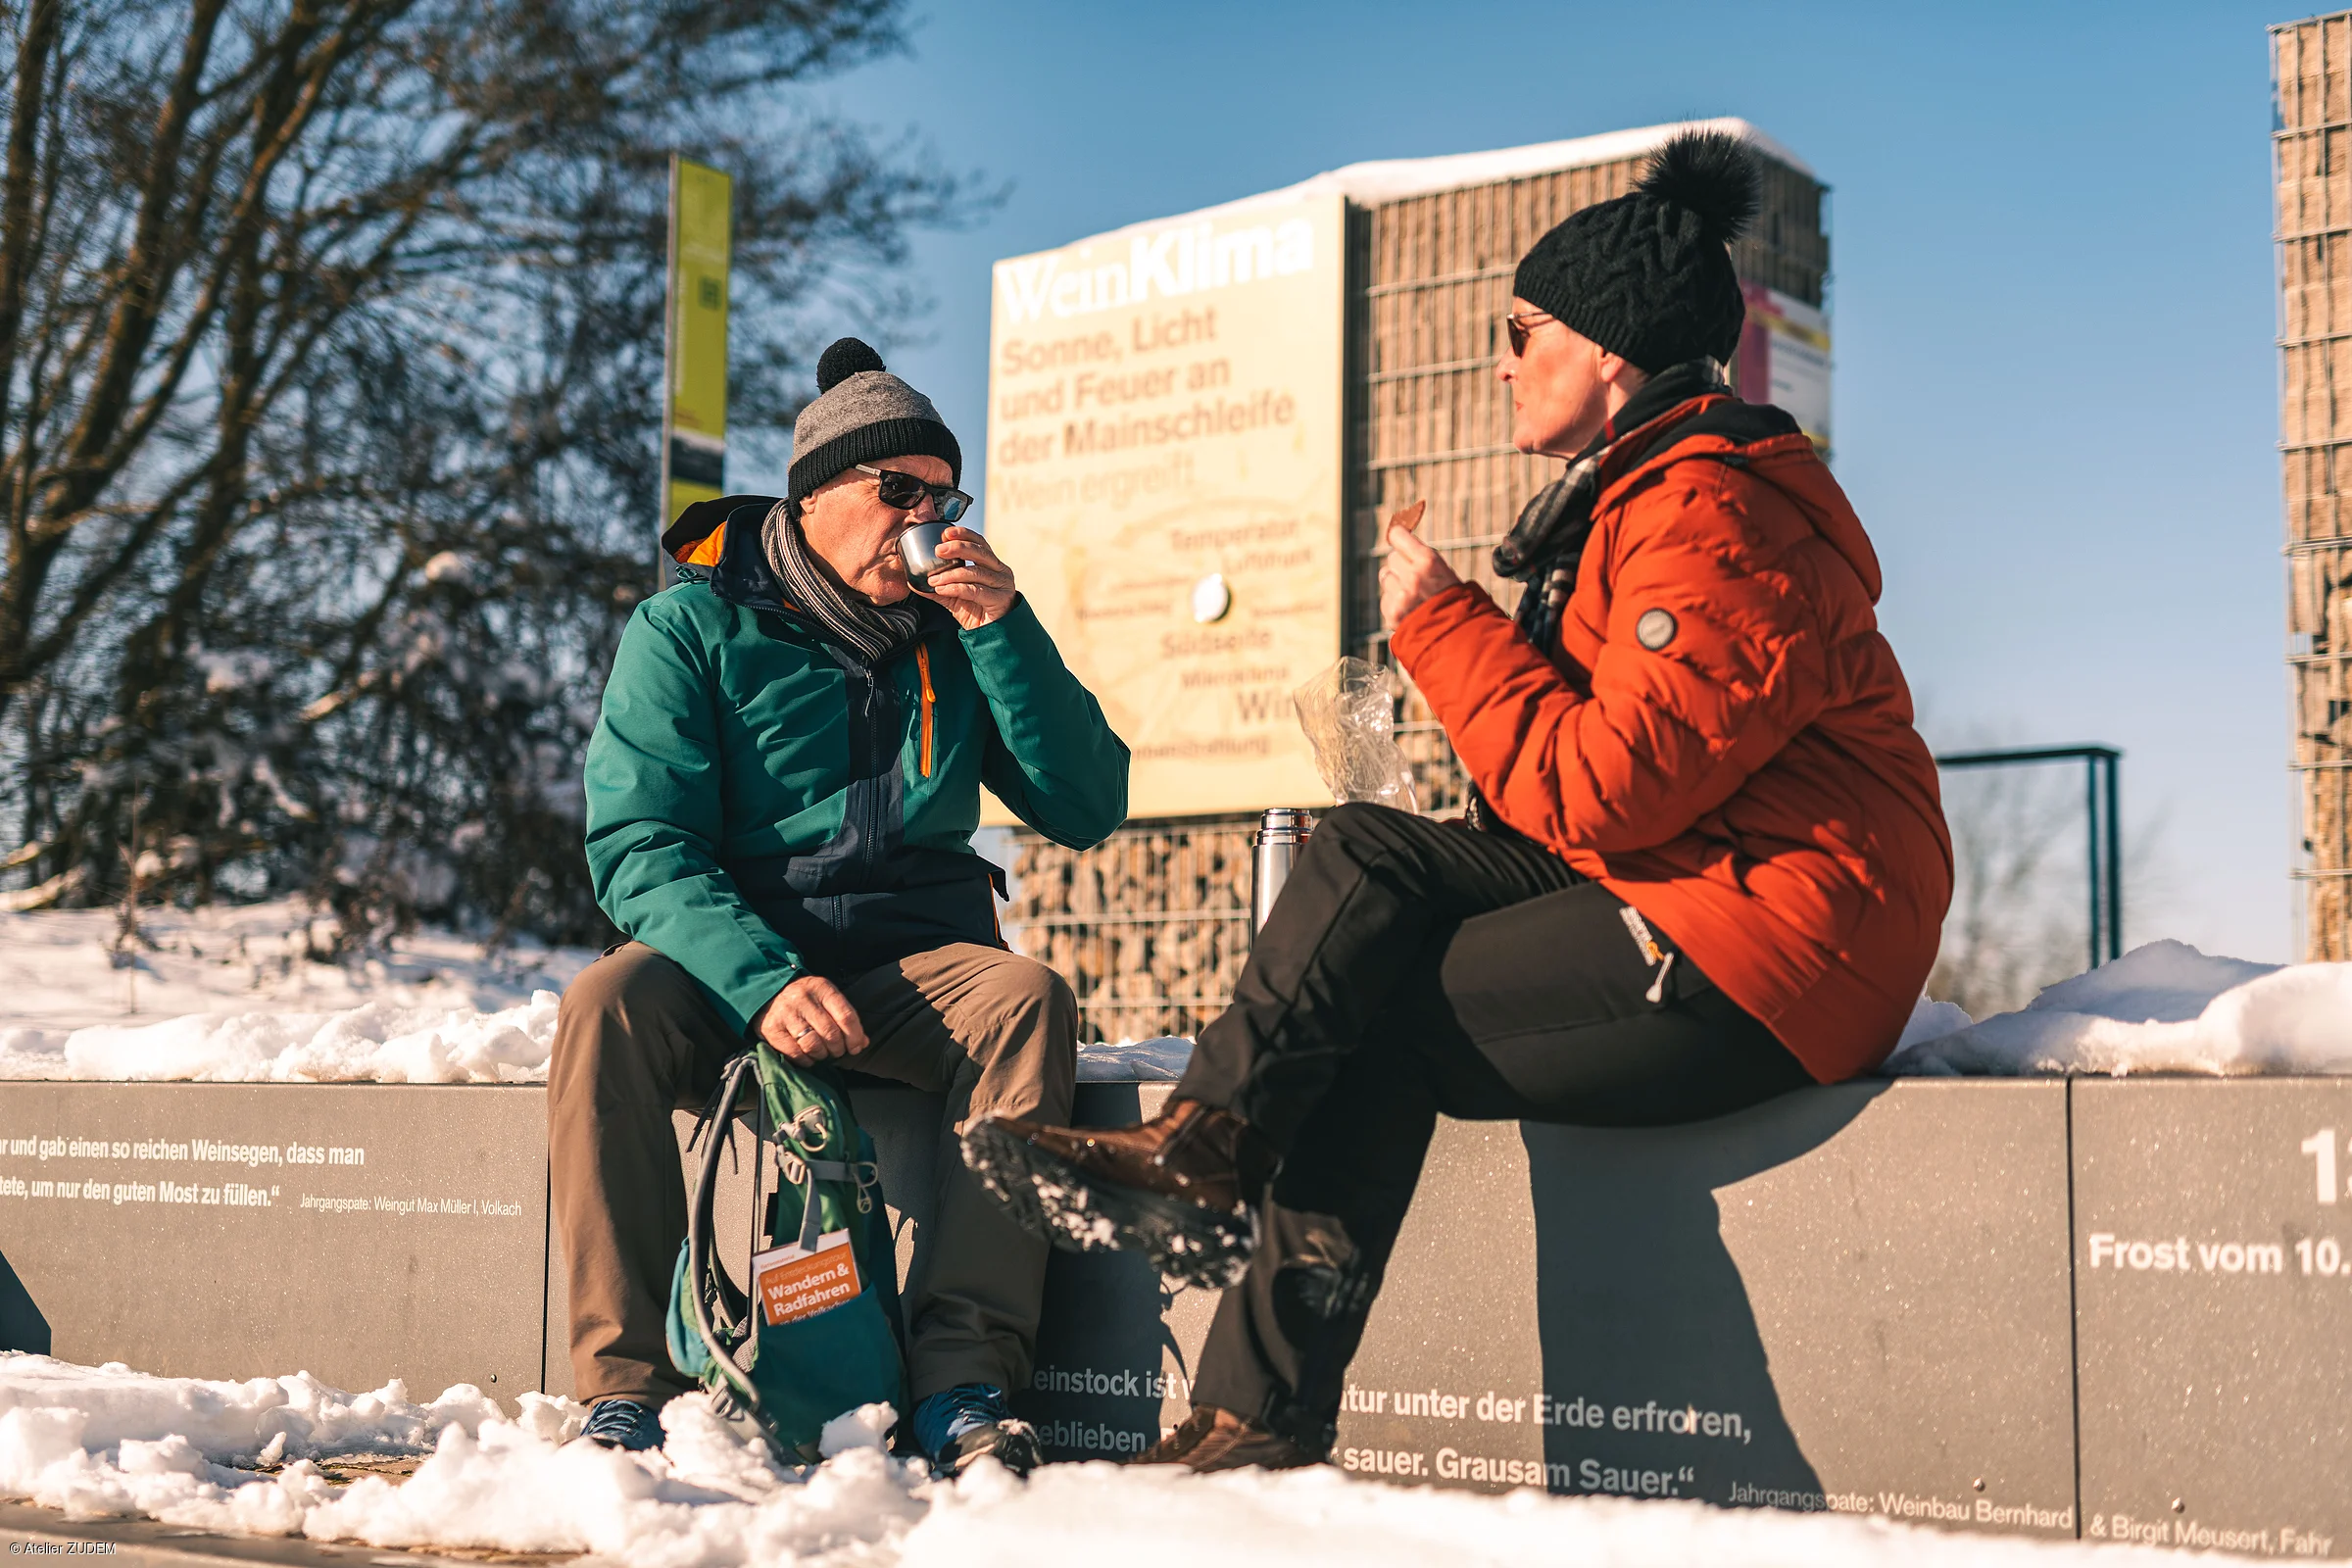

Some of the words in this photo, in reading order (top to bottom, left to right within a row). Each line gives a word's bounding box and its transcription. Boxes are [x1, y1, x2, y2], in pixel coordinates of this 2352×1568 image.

[996, 219, 1314, 324] WeinKlima
[1002, 330, 1123, 377] Sonne,
[1131, 306, 1218, 354] Licht
[1000, 380, 1064, 422] und
[1074, 367, 1176, 412] Feuer
[1186, 357, 1231, 393] an
[998, 430, 1054, 467] der
[1063, 392, 1297, 458] Mainschleife
[1237, 692, 1294, 723] Wi
[11, 1135, 37, 1156] und
[39, 1135, 66, 1161] gab
[69, 1137, 109, 1158] einen
[112, 1141, 130, 1159] so
[133, 1138, 188, 1160] reichen
[192, 1139, 283, 1167] Weinsegen,
[286, 1142, 324, 1164] dass
[328, 1146, 365, 1165] man
[2300, 1128, 2352, 1204] 1
[31, 1180, 54, 1198] um
[57, 1182, 80, 1199] nur
[83, 1178, 110, 1200] den
[114, 1181, 156, 1205] guten
[159, 1181, 199, 1203] Most
[201, 1186, 220, 1204] zu
[300, 1193, 371, 1214] Jahrgangspate:
[373, 1196, 416, 1216] Weingut
[417, 1197, 439, 1214] Max
[440, 1198, 472, 1215] Müller
[481, 1200, 521, 1217] Volkach
[766, 1267, 836, 1301] Wandern
[836, 1261, 851, 1278] &
[2088, 1232, 2191, 1271] Frost
[2197, 1241, 2283, 1273] vom
[2294, 1237, 2352, 1276] 10.
[772, 1282, 852, 1317] Radfahren
[1033, 1365, 1140, 1397] einstock
[1146, 1370, 1177, 1399] ist
[1395, 1388, 1469, 1420] unter
[1476, 1390, 1526, 1424] der
[1533, 1393, 1605, 1429] Erde
[1612, 1398, 1752, 1445] erfroren,
[1035, 1420, 1146, 1453] eblieben
[1344, 1447, 1429, 1477] sauer.
[1436, 1446, 1571, 1488] Grausam
[1728, 1480, 1875, 1514] Jahrgangspate:
[1879, 1492, 1970, 1522] Weinbau
[1975, 1497, 2074, 1530] Bernhard
[2089, 1513, 2106, 1538] &
[2111, 1514, 2169, 1546] Birgit
[2174, 1519, 2274, 1556] Meusert,
[2278, 1527, 2332, 1557] Fahr
